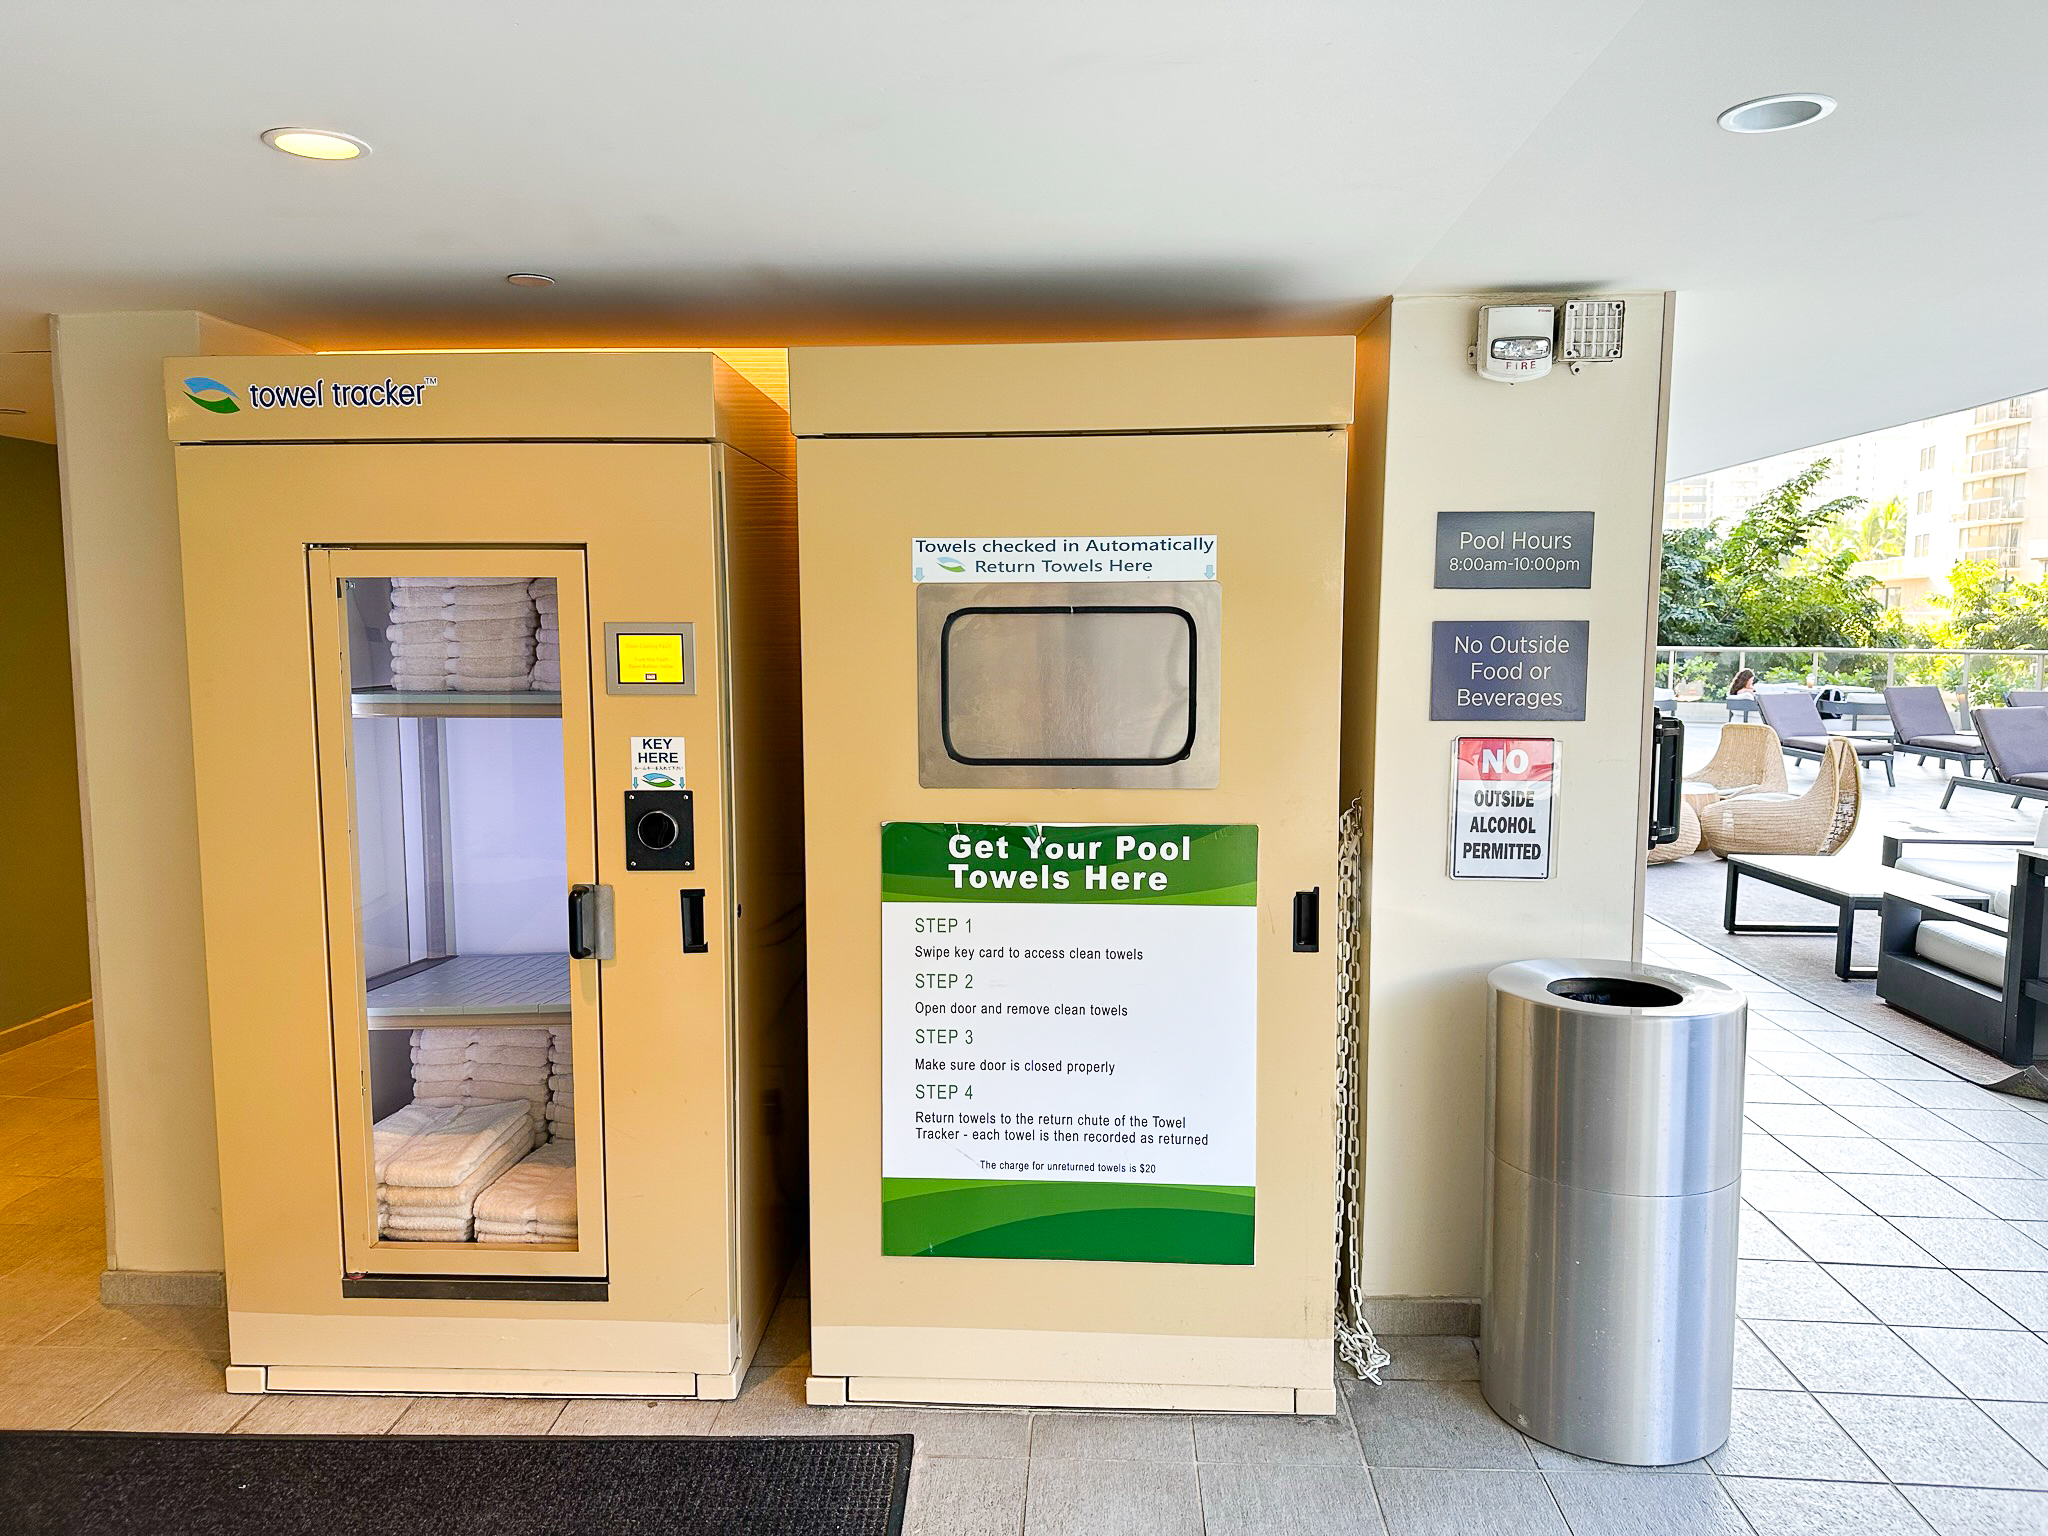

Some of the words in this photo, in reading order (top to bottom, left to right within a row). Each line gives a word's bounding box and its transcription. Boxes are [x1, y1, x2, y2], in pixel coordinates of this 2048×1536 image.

[1506, 361, 1536, 370] FIRE
[249, 380, 323, 408] towel
[916, 540, 977, 553] Towels
[982, 540, 1057, 553] checked
[1064, 539, 1079, 552] in
[1086, 538, 1214, 554] Automatically
[1460, 531, 1504, 549] Pool
[1512, 532, 1572, 549] Hours
[976, 560, 1035, 573] Return
[1042, 560, 1103, 573] Towels
[1109, 559, 1153, 572] Here
[1450, 557, 1580, 573] 8:00am-10:00pm
[1455, 636, 1483, 654] No
[1490, 635, 1570, 654] Outside
[1471, 662, 1523, 680] Food
[1530, 665, 1551, 680] or
[1457, 689, 1563, 710] Beverages
[643, 739, 672, 749] KEY
[638, 752, 678, 763] HERE
[1482, 749, 1529, 774] NO
[1474, 790, 1534, 807] OUTSIDE
[1470, 816, 1536, 833] ALCOHOL
[948, 834, 1009, 859] Get
[1023, 836, 1102, 860] Your
[1116, 836, 1190, 861] Pool
[1463, 842, 1541, 860] PERMITTED
[948, 864, 1070, 889] Towels
[1085, 866, 1168, 891] Here
[915, 918, 958, 933] STEP
[965, 918, 972, 933] 1
[914, 946, 950, 961] Swipe
[954, 946, 974, 960] key
[979, 946, 1004, 959] card
[1008, 947, 1020, 959] to
[1024, 949, 1065, 960] access
[1069, 948, 1101, 960] clean
[1105, 949, 1143, 961] towels
[915, 974, 958, 989] STEP
[965, 974, 973, 989] 2
[915, 1001, 946, 1016] Open
[951, 1002, 977, 1014] door
[981, 1002, 1002, 1015] and
[1006, 1004, 1049, 1016] remove
[1054, 1004, 1086, 1016] clean
[1090, 1004, 1128, 1017] towels
[915, 1029, 959, 1045] STEP
[965, 1030, 973, 1045] 3
[915, 1059, 946, 1071] Make
[951, 1061, 976, 1071] sure
[980, 1059, 1006, 1072] door
[1010, 1060, 1020, 1072] is
[1024, 1060, 1062, 1073] closed
[1067, 1061, 1115, 1075] properly
[915, 1084, 959, 1100] STEP
[964, 1085, 973, 1100] 4
[915, 1112, 954, 1123] Return
[959, 1112, 996, 1124] towels
[1000, 1113, 1012, 1125] to
[1016, 1113, 1034, 1125] the
[1038, 1114, 1073, 1126] return
[1077, 1114, 1110, 1127] chute
[1114, 1115, 1126, 1127] of
[1130, 1115, 1148, 1127] the
[1152, 1116, 1186, 1129] Towel
[915, 1128, 960, 1140] Tracker
[972, 1129, 1000, 1141] each
[1004, 1129, 1035, 1141] towel
[1040, 1130, 1049, 1141] is
[1053, 1130, 1079, 1142] then
[1084, 1130, 1135, 1144] recorded
[1140, 1133, 1154, 1144] as
[1158, 1132, 1208, 1146] returned
[980, 1160, 996, 1169] The
[999, 1161, 1029, 1172] charge
[1032, 1161, 1044, 1170] for
[1047, 1162, 1095, 1172] unreturned
[1098, 1163, 1126, 1173] towels
[1129, 1163, 1137, 1173] is
[1139, 1163, 1156, 1174] $20
